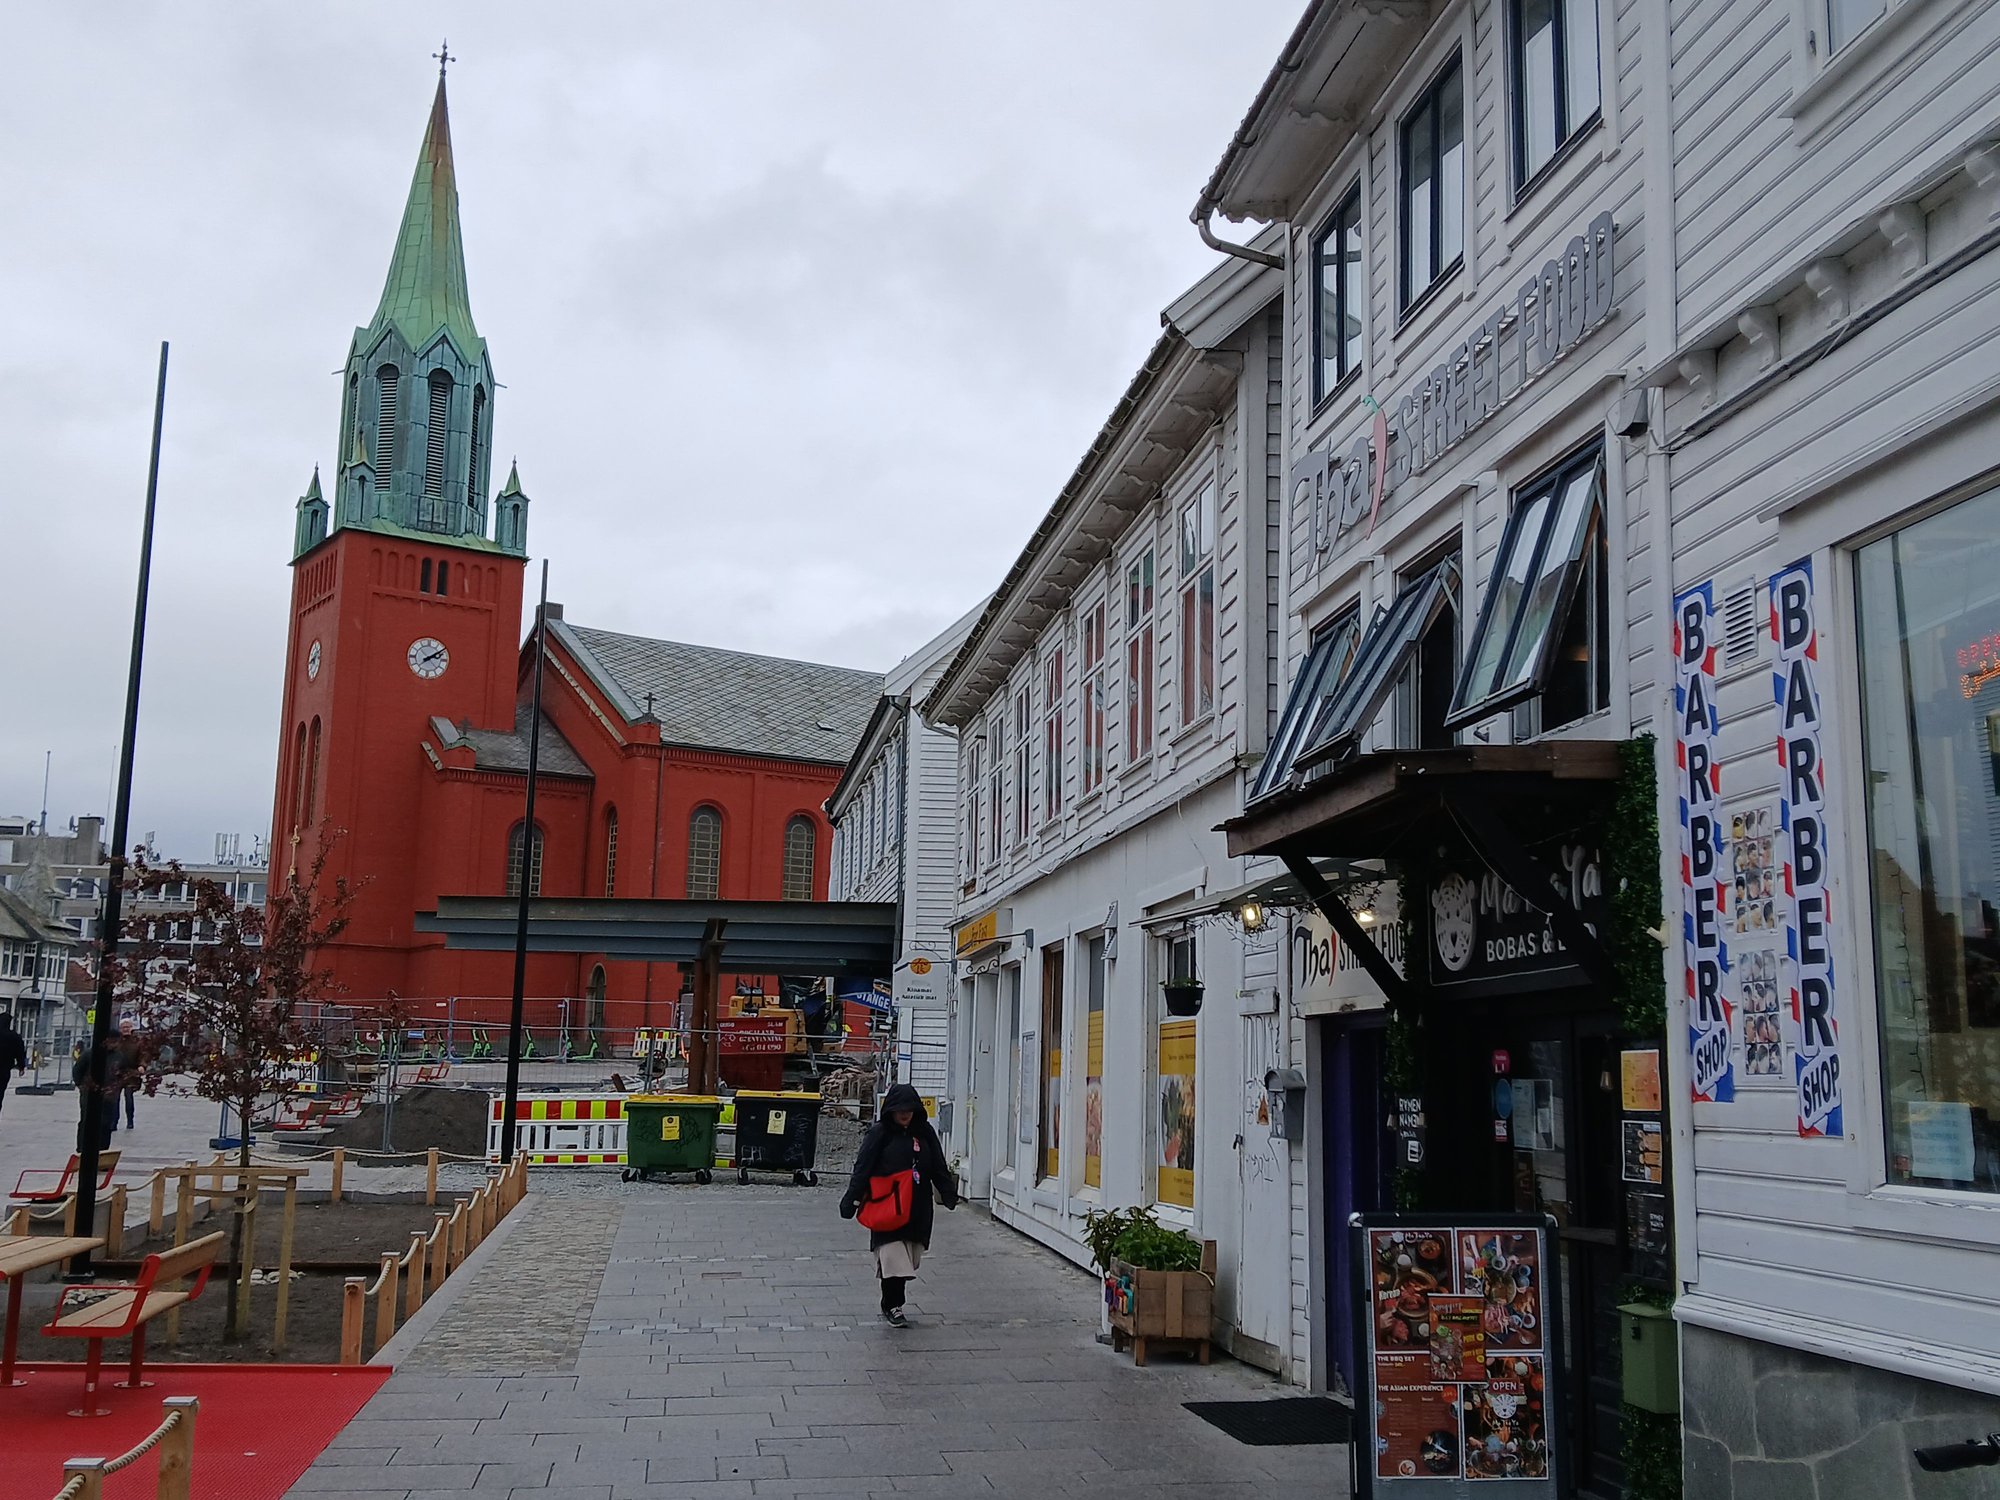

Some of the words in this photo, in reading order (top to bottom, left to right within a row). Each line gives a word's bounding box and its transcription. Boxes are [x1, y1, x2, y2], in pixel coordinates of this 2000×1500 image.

[1396, 303, 1506, 484] STREET
[1518, 210, 1615, 384] FOOD
[1684, 601, 1723, 1023] BARBER
[1783, 580, 1836, 1047] BARBER
[1486, 932, 1536, 962] BOBAS
[1541, 929, 1553, 955] &
[1696, 1027, 1727, 1087] SHOP
[1802, 1052, 1841, 1119] SHOP
[1390, 1384, 1409, 1392] ASIAN
[1409, 1384, 1444, 1392] EXPERIENCE
[1492, 1381, 1517, 1391] OPEN
